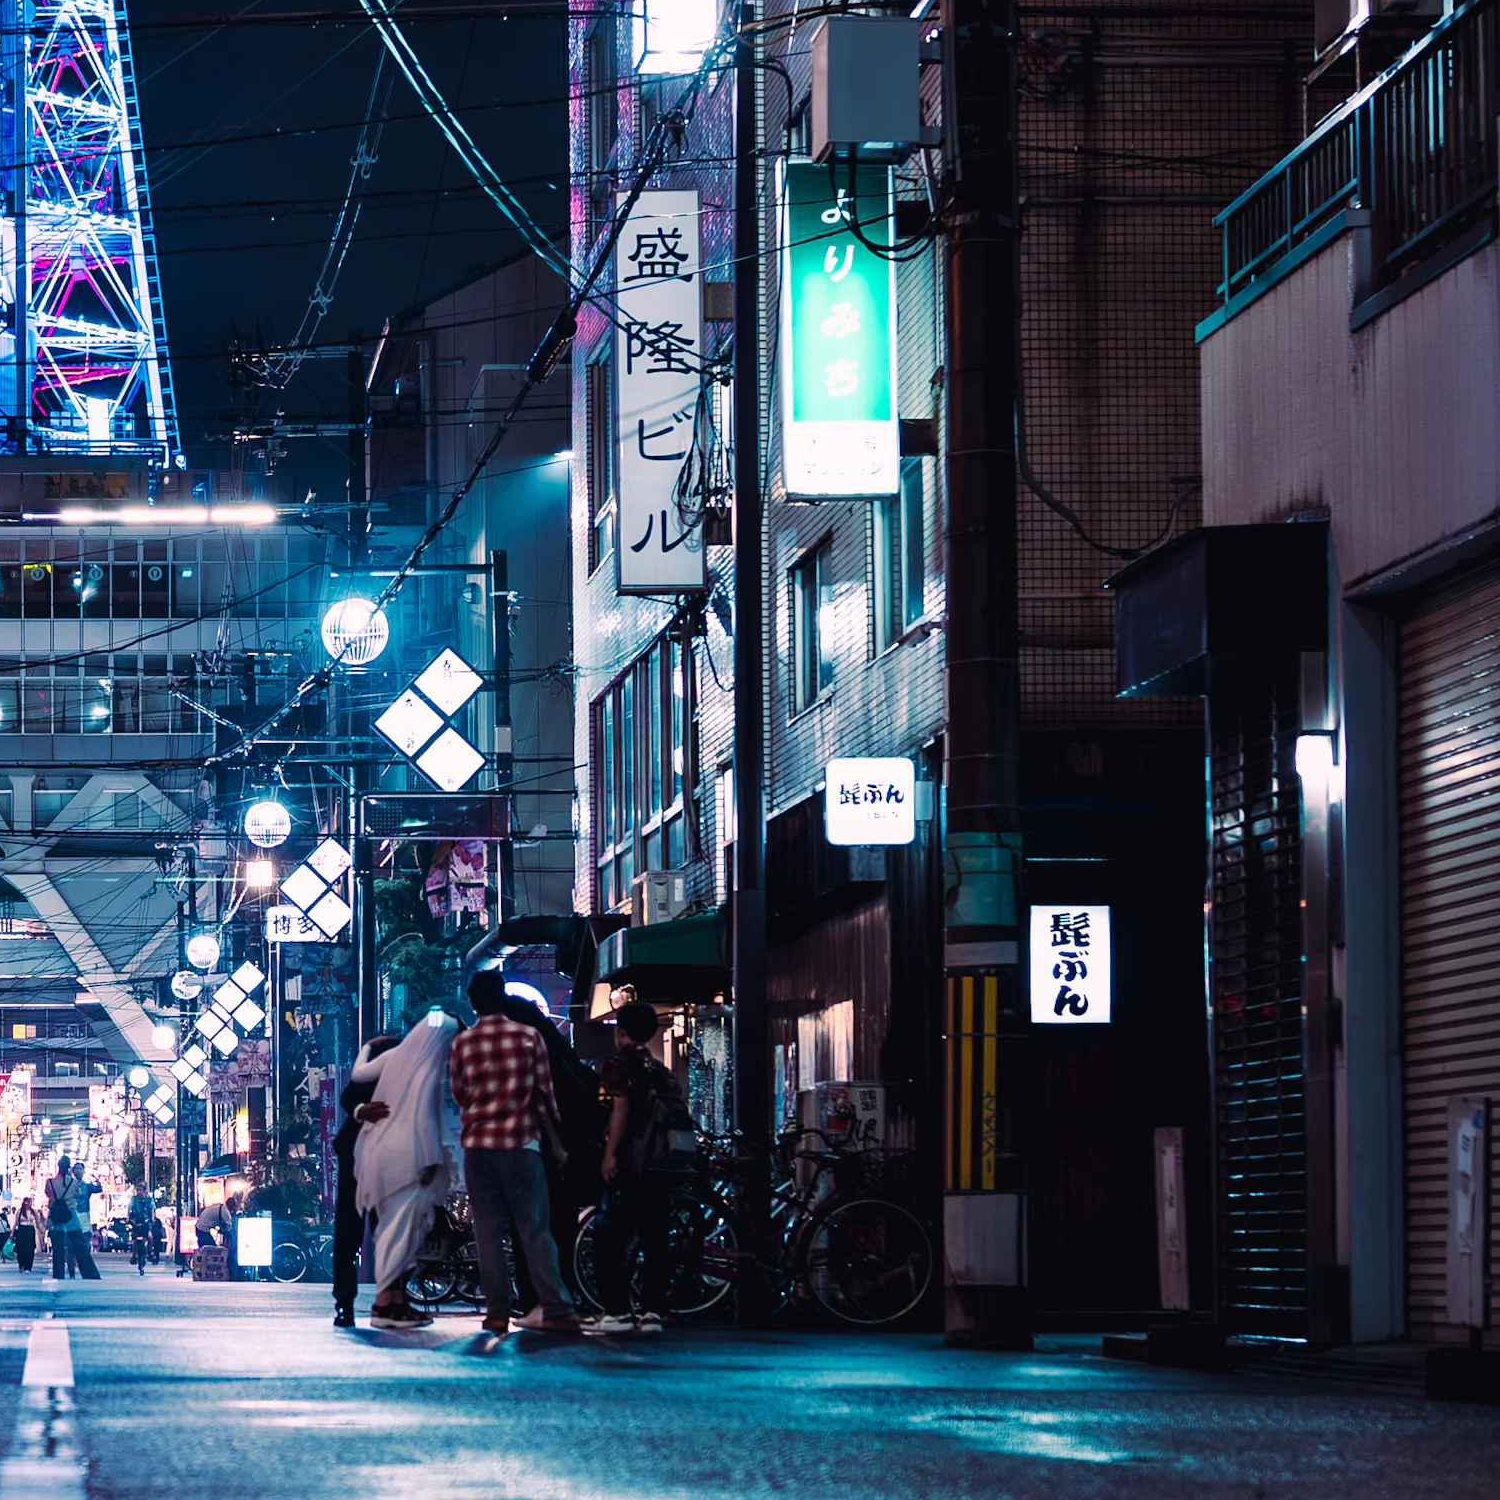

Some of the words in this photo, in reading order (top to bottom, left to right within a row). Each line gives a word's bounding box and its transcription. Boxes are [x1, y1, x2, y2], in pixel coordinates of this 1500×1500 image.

[624, 227, 695, 554] 盛隆ビル
[820, 189, 861, 397] よりみち
